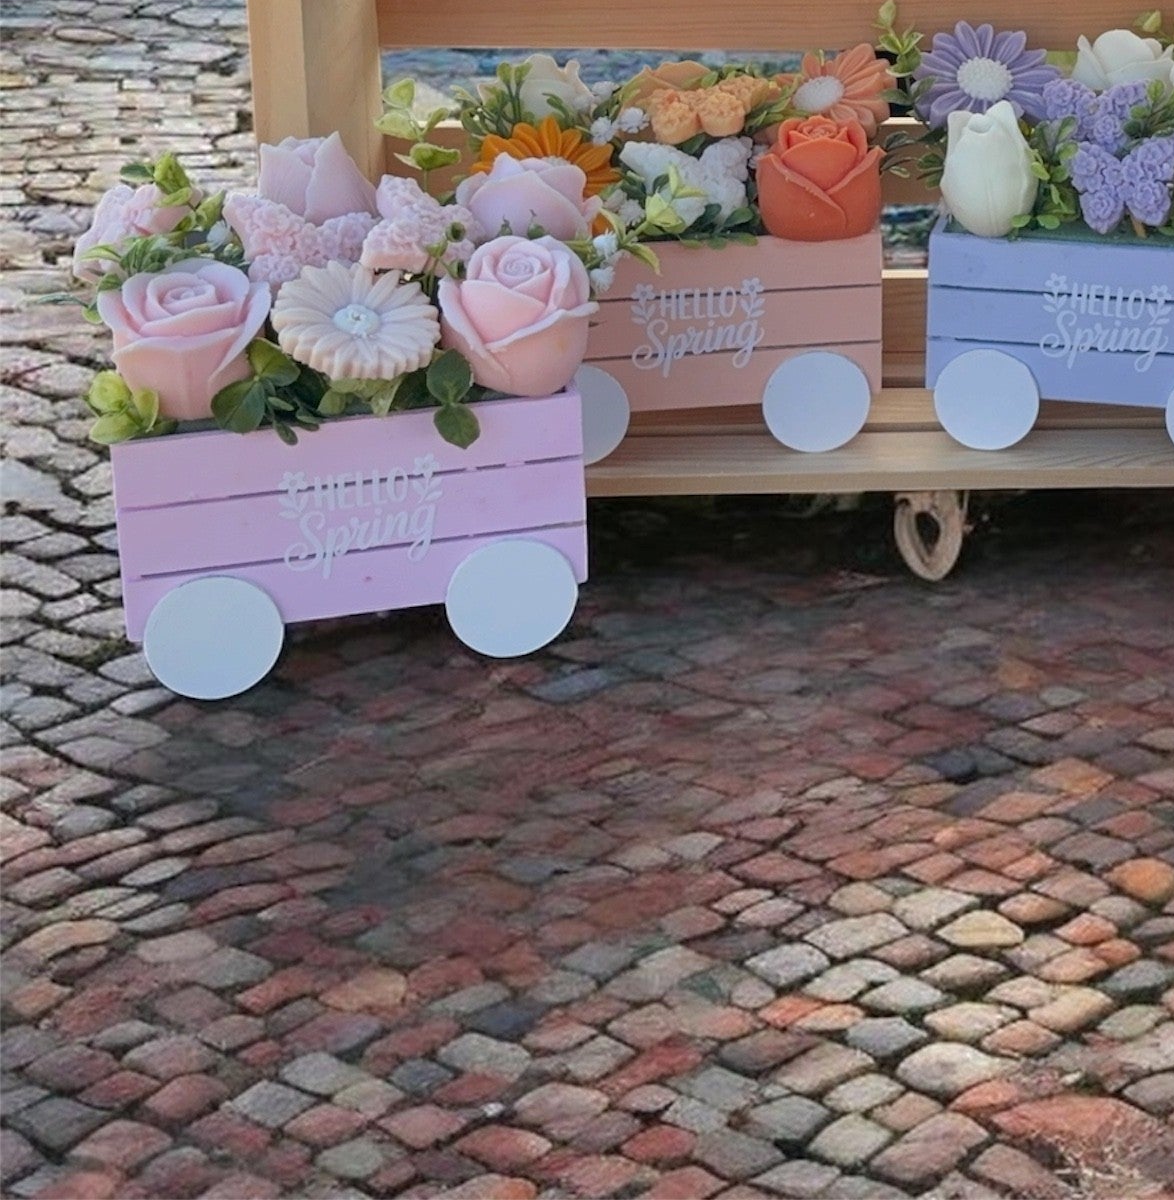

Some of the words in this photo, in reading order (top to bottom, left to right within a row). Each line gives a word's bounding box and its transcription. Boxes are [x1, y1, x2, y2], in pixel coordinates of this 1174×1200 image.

[659, 285, 736, 320] HELLO
[1070, 282, 1145, 320] HELLO
[631, 319, 765, 378] Spring
[1040, 310, 1168, 372] Spring
[313, 467, 408, 511] HELLO
[285, 503, 437, 579] Spring
